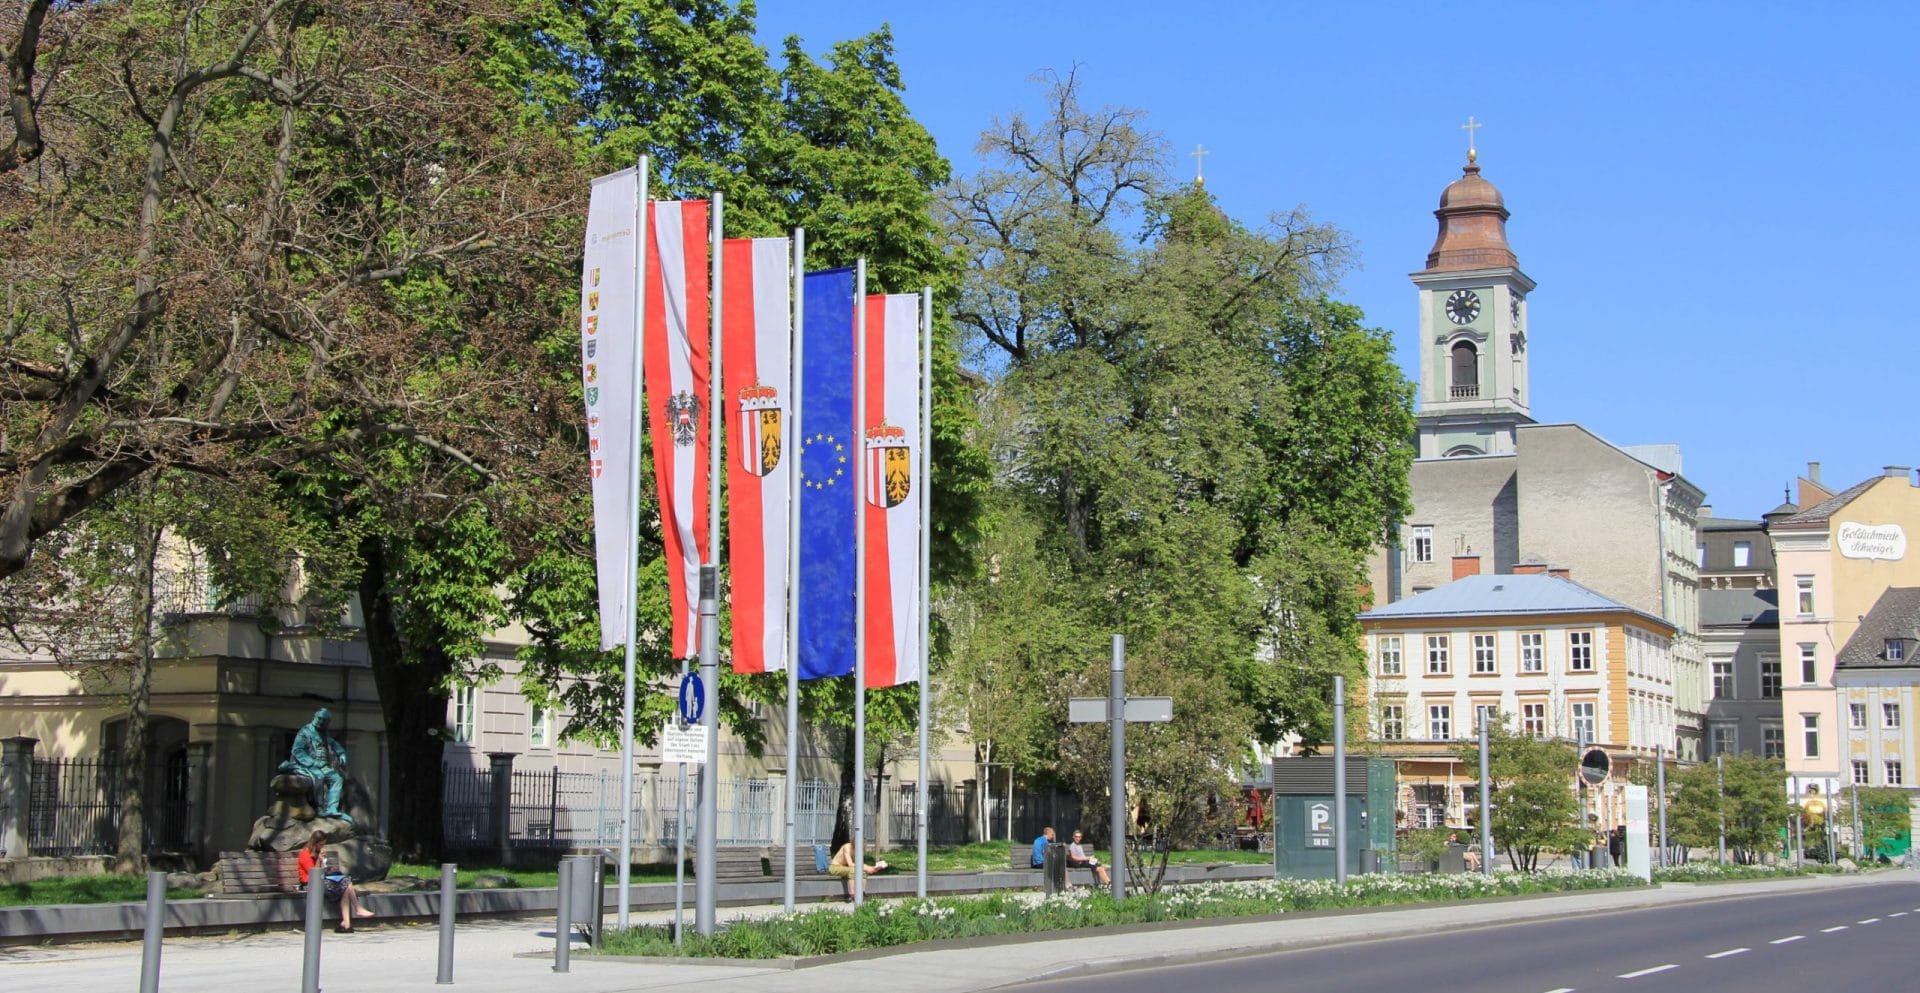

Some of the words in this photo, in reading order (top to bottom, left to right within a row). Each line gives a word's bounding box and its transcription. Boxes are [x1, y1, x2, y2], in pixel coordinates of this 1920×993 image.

[1842, 528, 1899, 541] Goldschmiede
[1851, 542, 1895, 555] Schweiger
[1312, 810, 1328, 830] P
